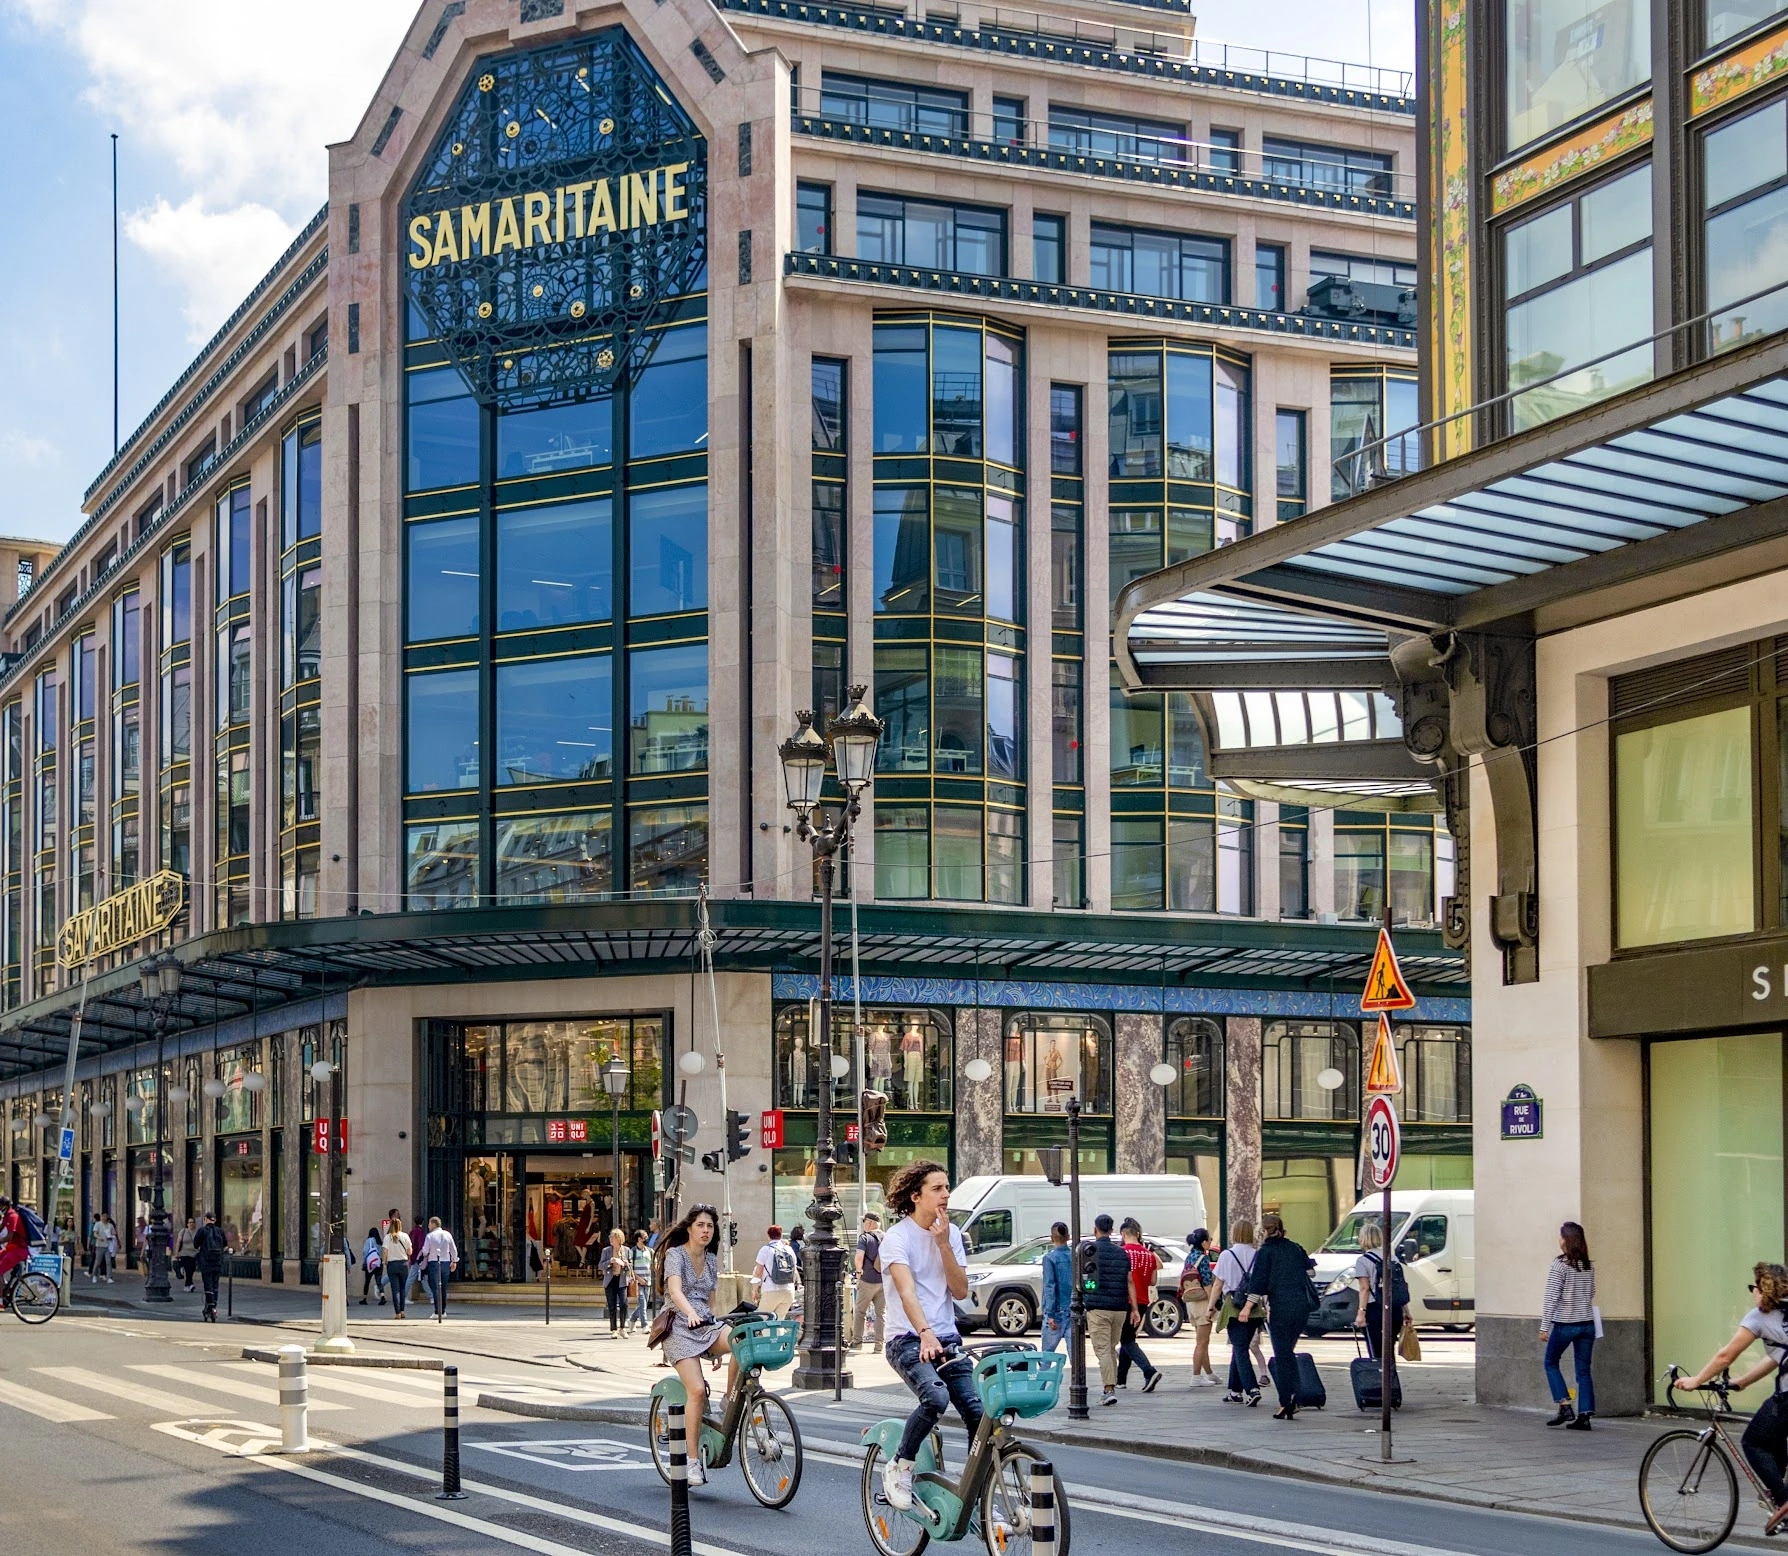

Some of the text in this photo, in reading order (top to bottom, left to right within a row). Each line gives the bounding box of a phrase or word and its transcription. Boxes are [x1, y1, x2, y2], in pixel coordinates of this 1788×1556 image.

[409, 161, 689, 270] SAMARITAINE
[64, 879, 166, 961] SAMARITAINE
[1752, 964, 1788, 1000] S
[1513, 1105, 1530, 1116] RUE
[570, 1123, 584, 1131] UNI
[763, 1115, 776, 1129] UNI
[1509, 1123, 1534, 1135] RIVOLI
[570, 1131, 585, 1140] QLO
[763, 1131, 776, 1147] QLO
[1372, 1122, 1390, 1161] 30
